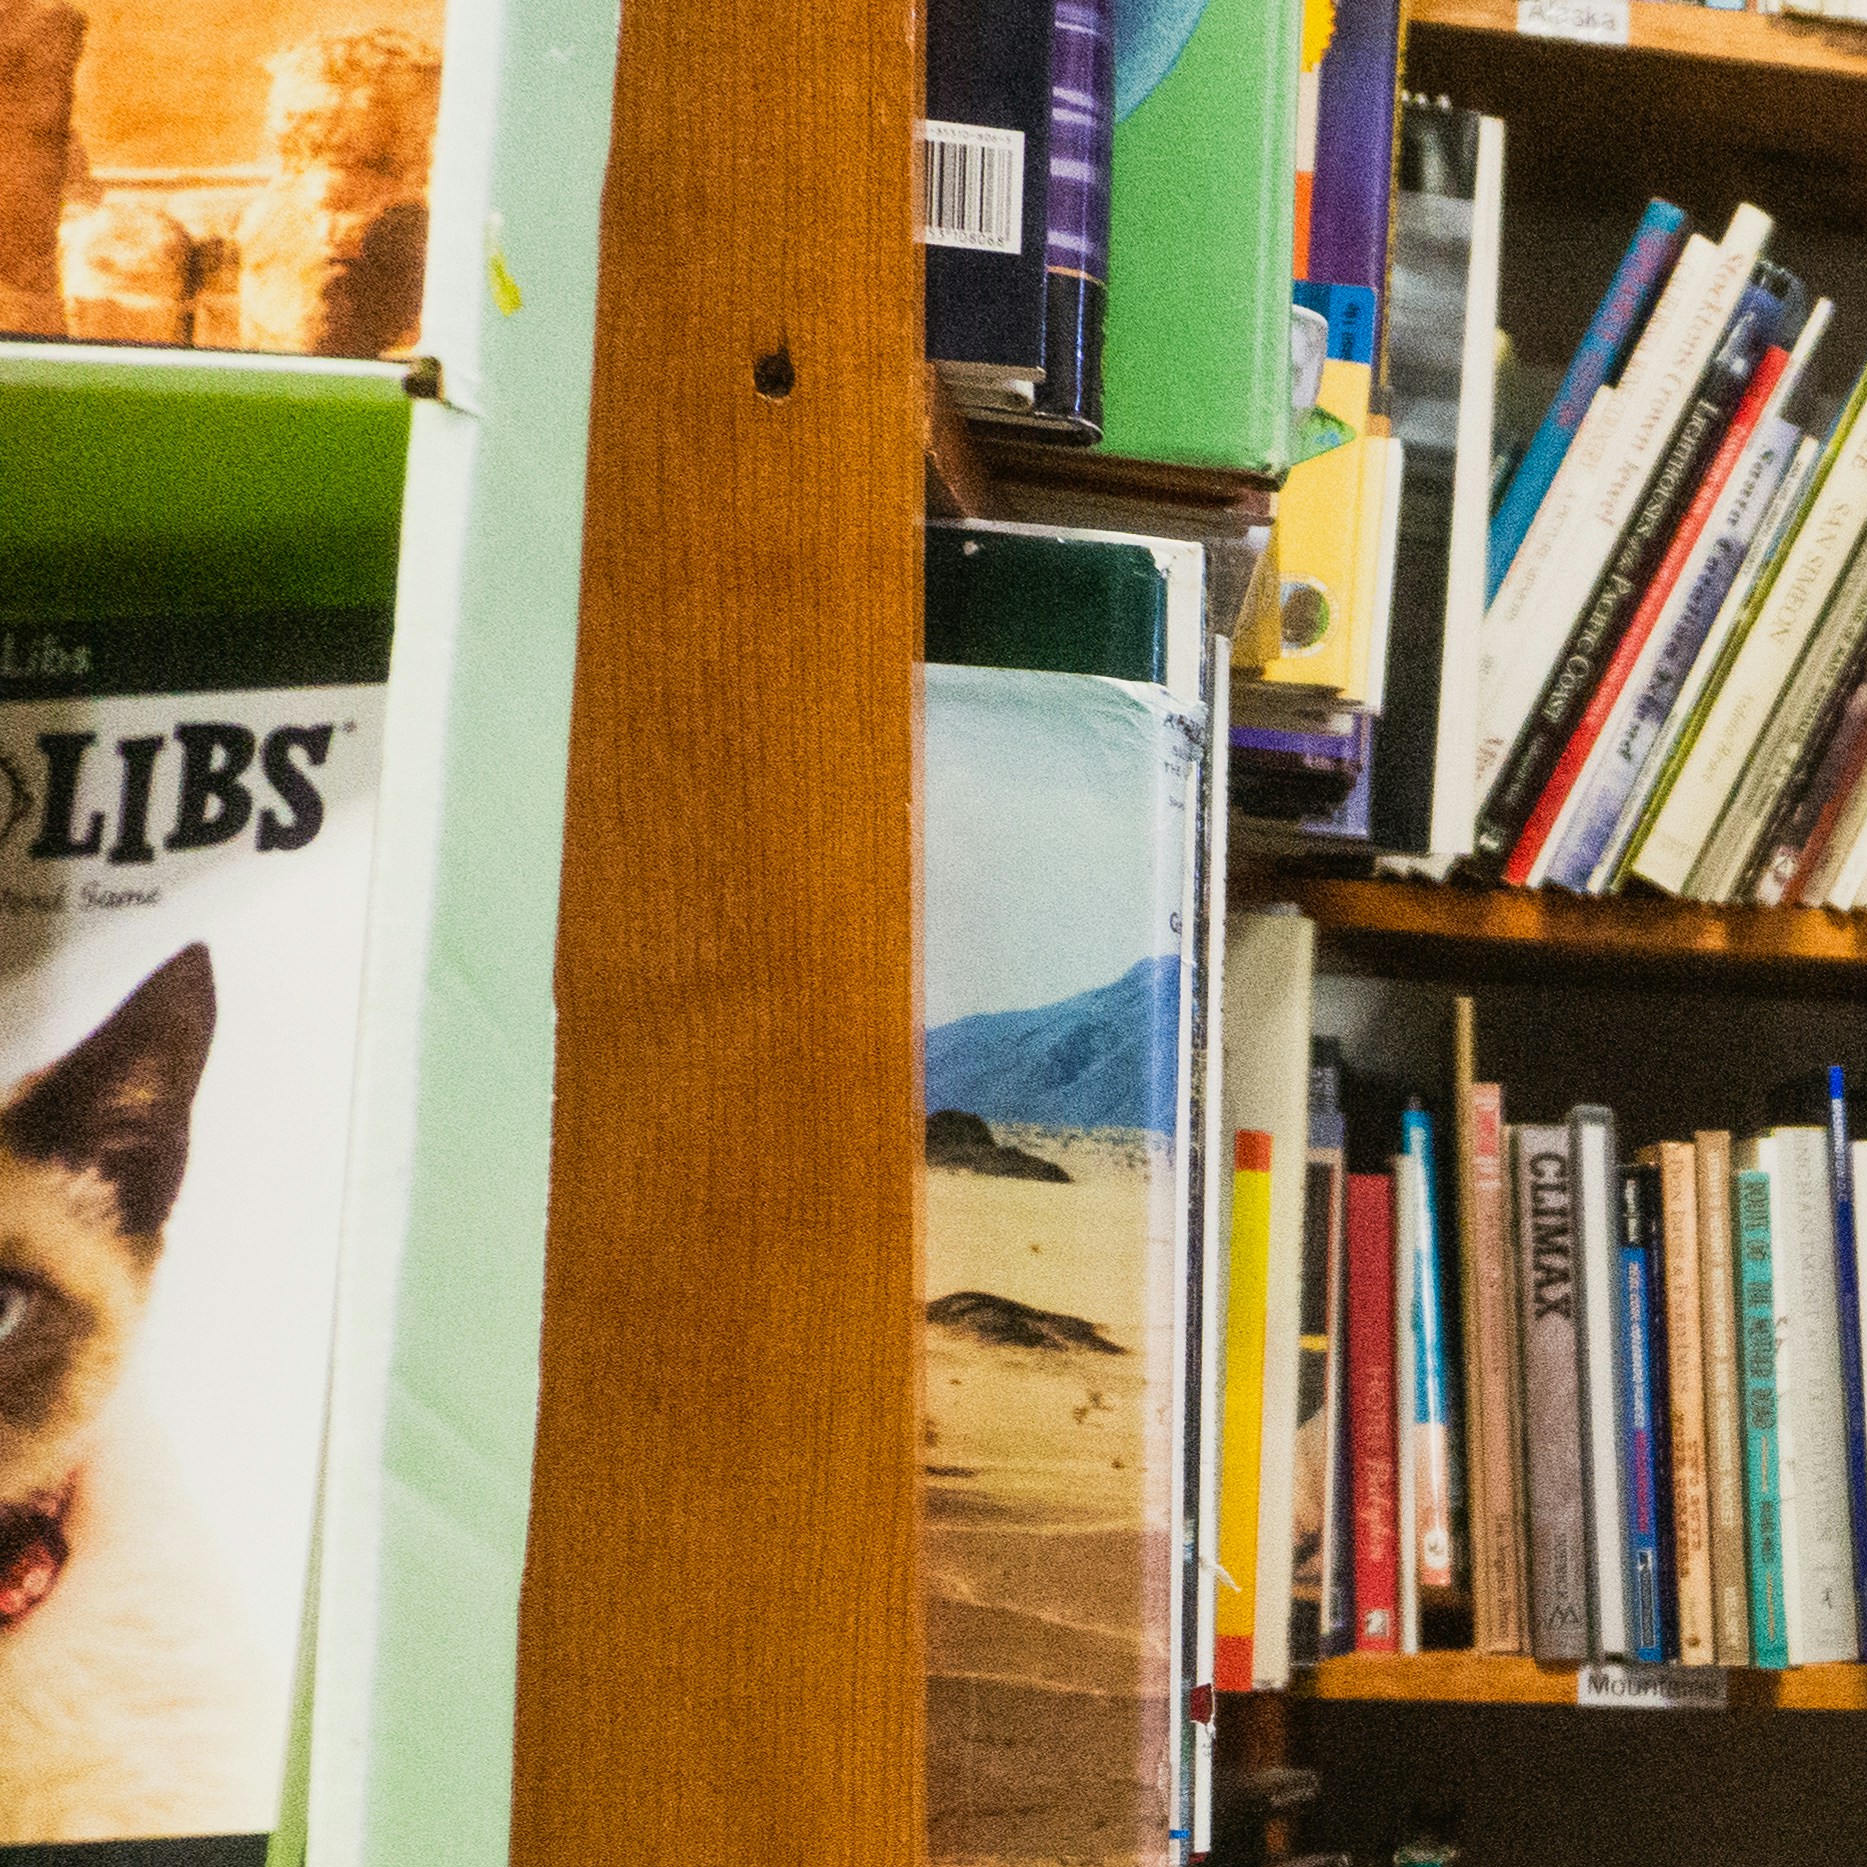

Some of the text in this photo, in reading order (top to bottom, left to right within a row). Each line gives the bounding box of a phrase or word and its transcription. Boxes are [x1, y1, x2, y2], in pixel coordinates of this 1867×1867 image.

[1629, 371, 1684, 455] Crown
[1592, 457, 1641, 528] Jewel
[1809, 494, 1854, 553] SAN
[1537, 396, 1719, 728] LIGHTHOUSES PACIFIC COAST
[1764, 549, 1829, 647] SIMEON
[30, 721, 335, 863] LIBS
[1525, 1150, 1575, 1320] CLIMAX
